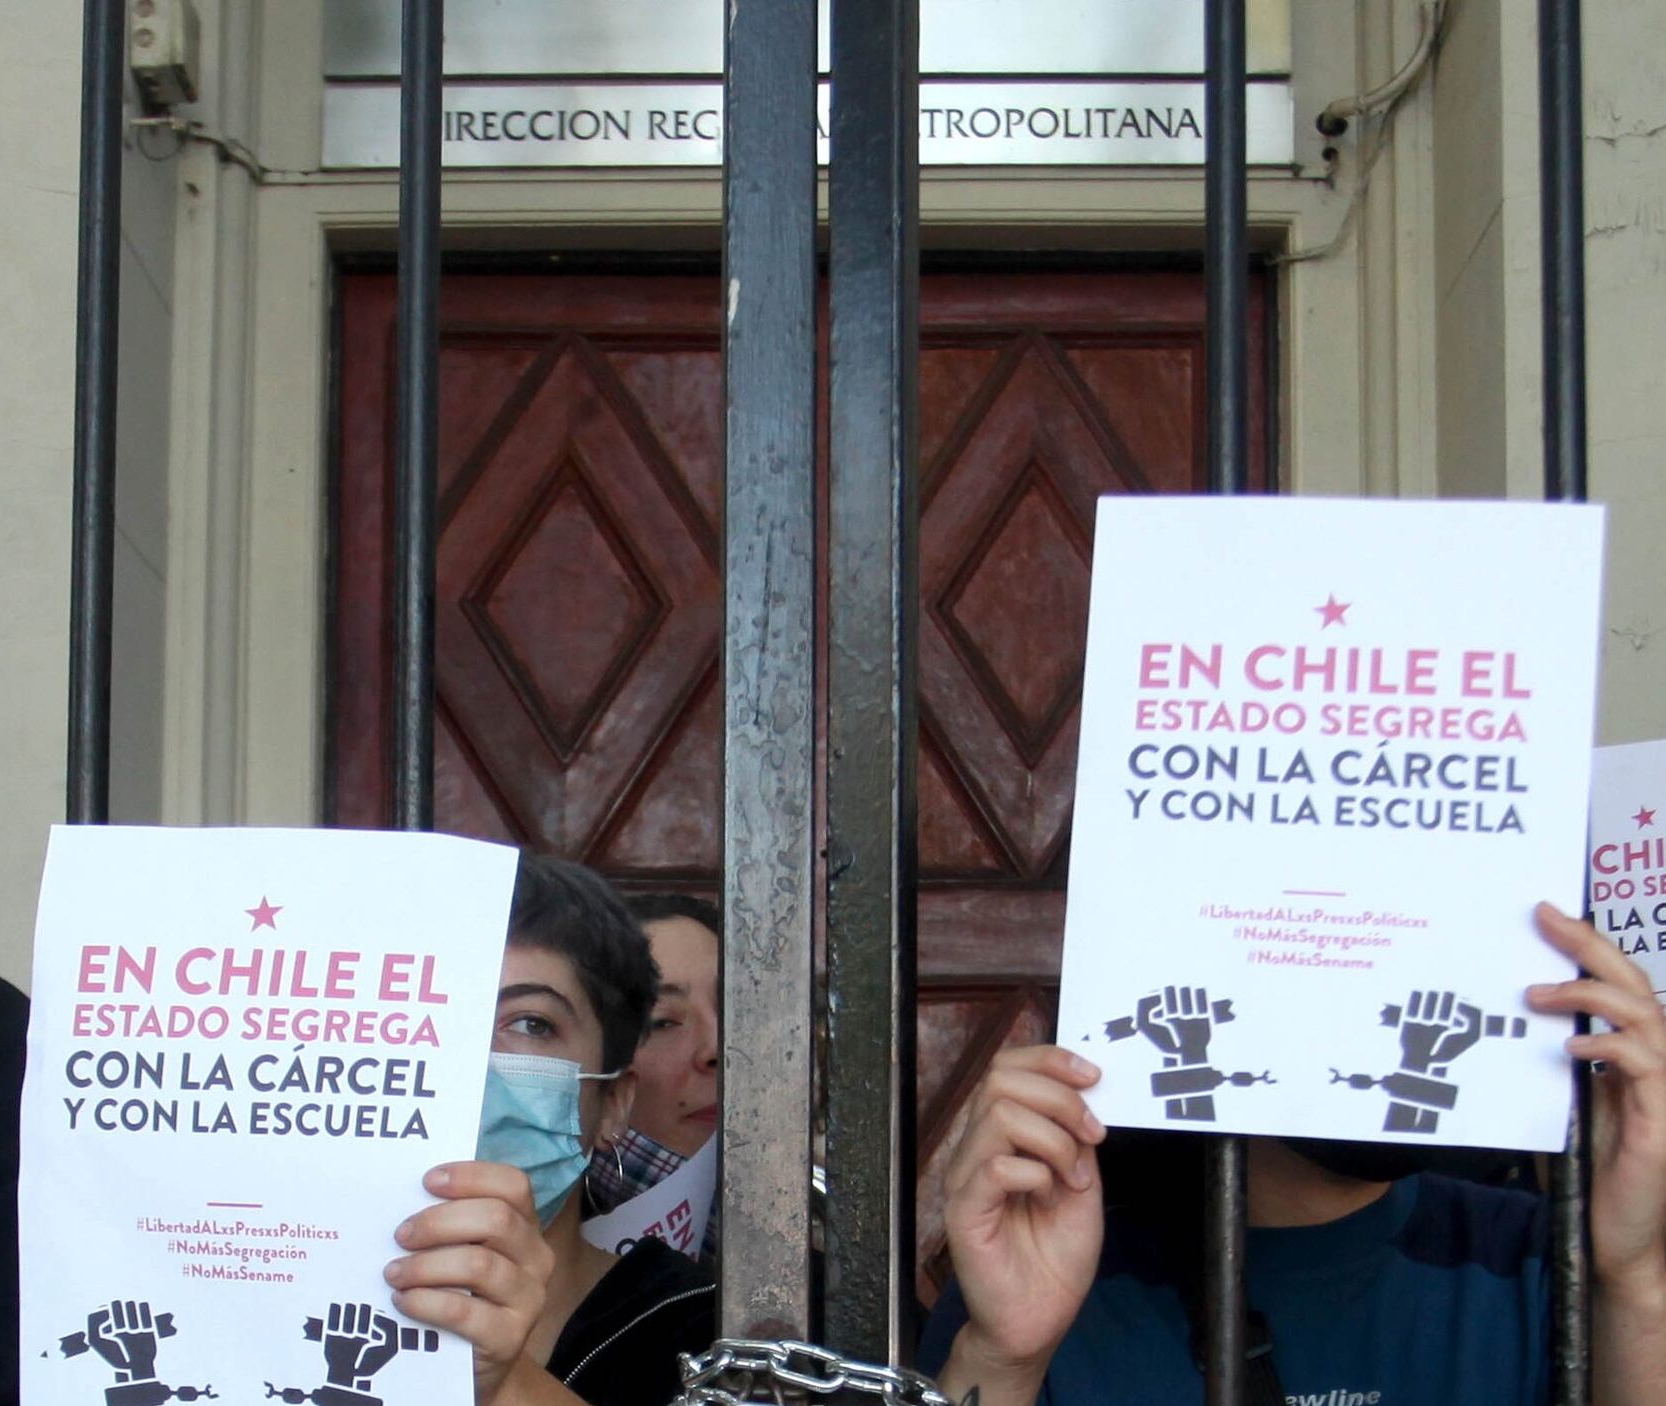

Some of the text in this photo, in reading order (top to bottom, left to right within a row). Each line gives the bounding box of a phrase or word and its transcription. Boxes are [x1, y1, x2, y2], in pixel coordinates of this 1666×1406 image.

[443, 109, 632, 142] IRECCION
[920, 107, 1202, 140] TROPOLITANA
[1138, 643, 1532, 700] EN CHILE EL
[1134, 699, 1528, 743] ESTADO SEGREGA
[1127, 738, 1529, 793] CON LA CÁRCEL
[1125, 788, 1526, 835] Y CON LA ESCUELA
[1607, 907, 1645, 932] LA
[77, 945, 448, 1004] EN CHILE EL
[72, 1004, 440, 1047] ESTADO SEGREGA
[65, 1043, 436, 1098] CON LA CÁRCEL
[63, 1097, 429, 1140] Y CON LA ESCUELA
[167, 1239, 307, 1263] #NoMásSegregación
[182, 1263, 294, 1283] #NoMásSename
